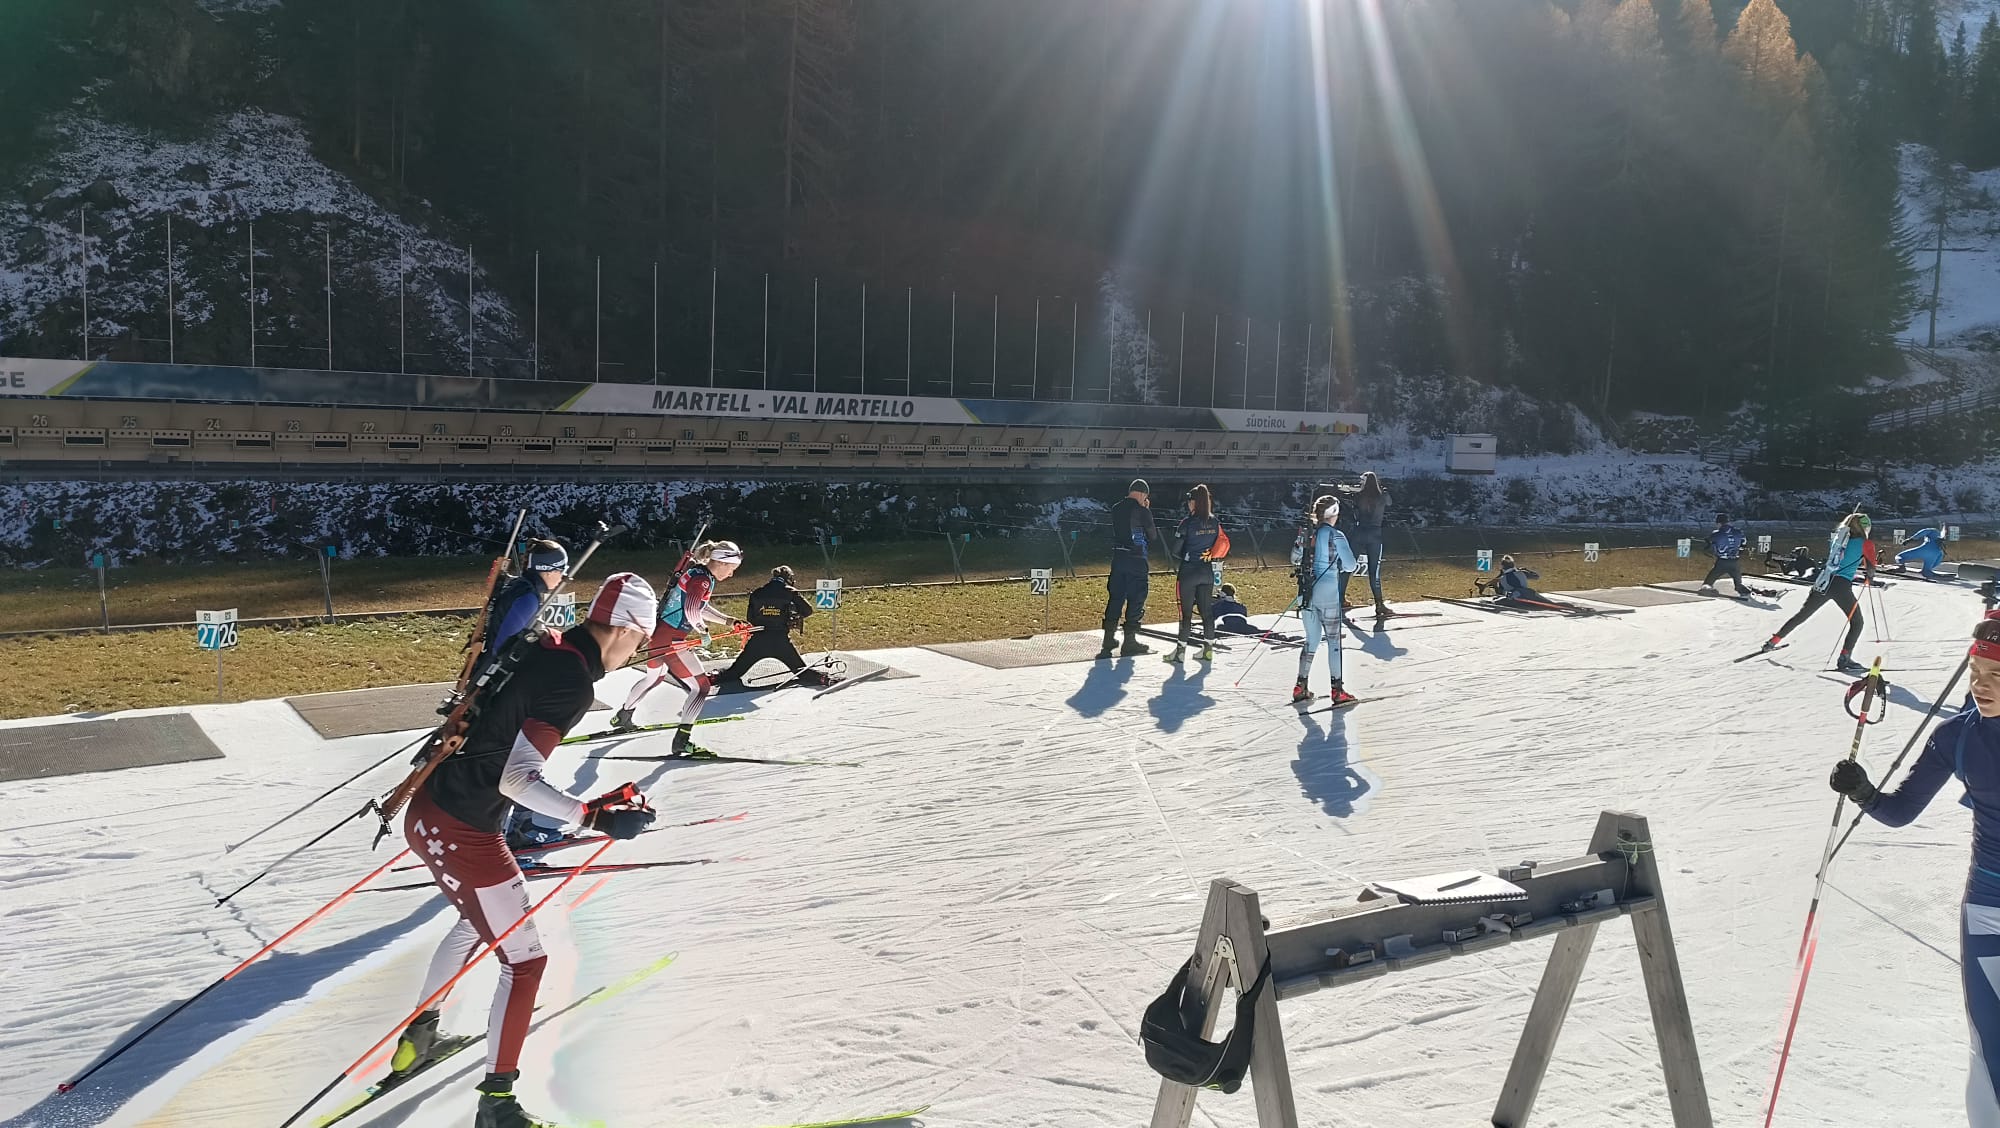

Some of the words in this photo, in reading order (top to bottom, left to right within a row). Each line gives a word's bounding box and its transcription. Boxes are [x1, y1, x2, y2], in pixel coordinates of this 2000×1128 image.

[652, 390, 751, 412] MARTELL
[772, 395, 808, 415] VAL
[815, 397, 914, 418] MARTELLO
[32, 414, 48, 427] 26
[122, 416, 137, 429] 25
[207, 419, 220, 431] 24
[287, 421, 300, 432] 23
[362, 422, 375, 433] 22
[434, 424, 445, 435] 21
[501, 426, 512, 436] 20
[565, 427, 575, 438] 19
[626, 428, 636, 438] 18
[1678, 545, 1690, 557] 19
[1758, 542, 1770, 553] 18
[1584, 550, 1598, 562] 20
[1353, 562, 1369, 577] 22
[1477, 557, 1490, 571] 21
[1031, 579, 1048, 595] 24
[816, 590, 835, 609] 25
[545, 606, 565, 627] 26
[566, 604, 576, 626] 25
[198, 623, 218, 648] 27
[219, 622, 238, 648] 26
